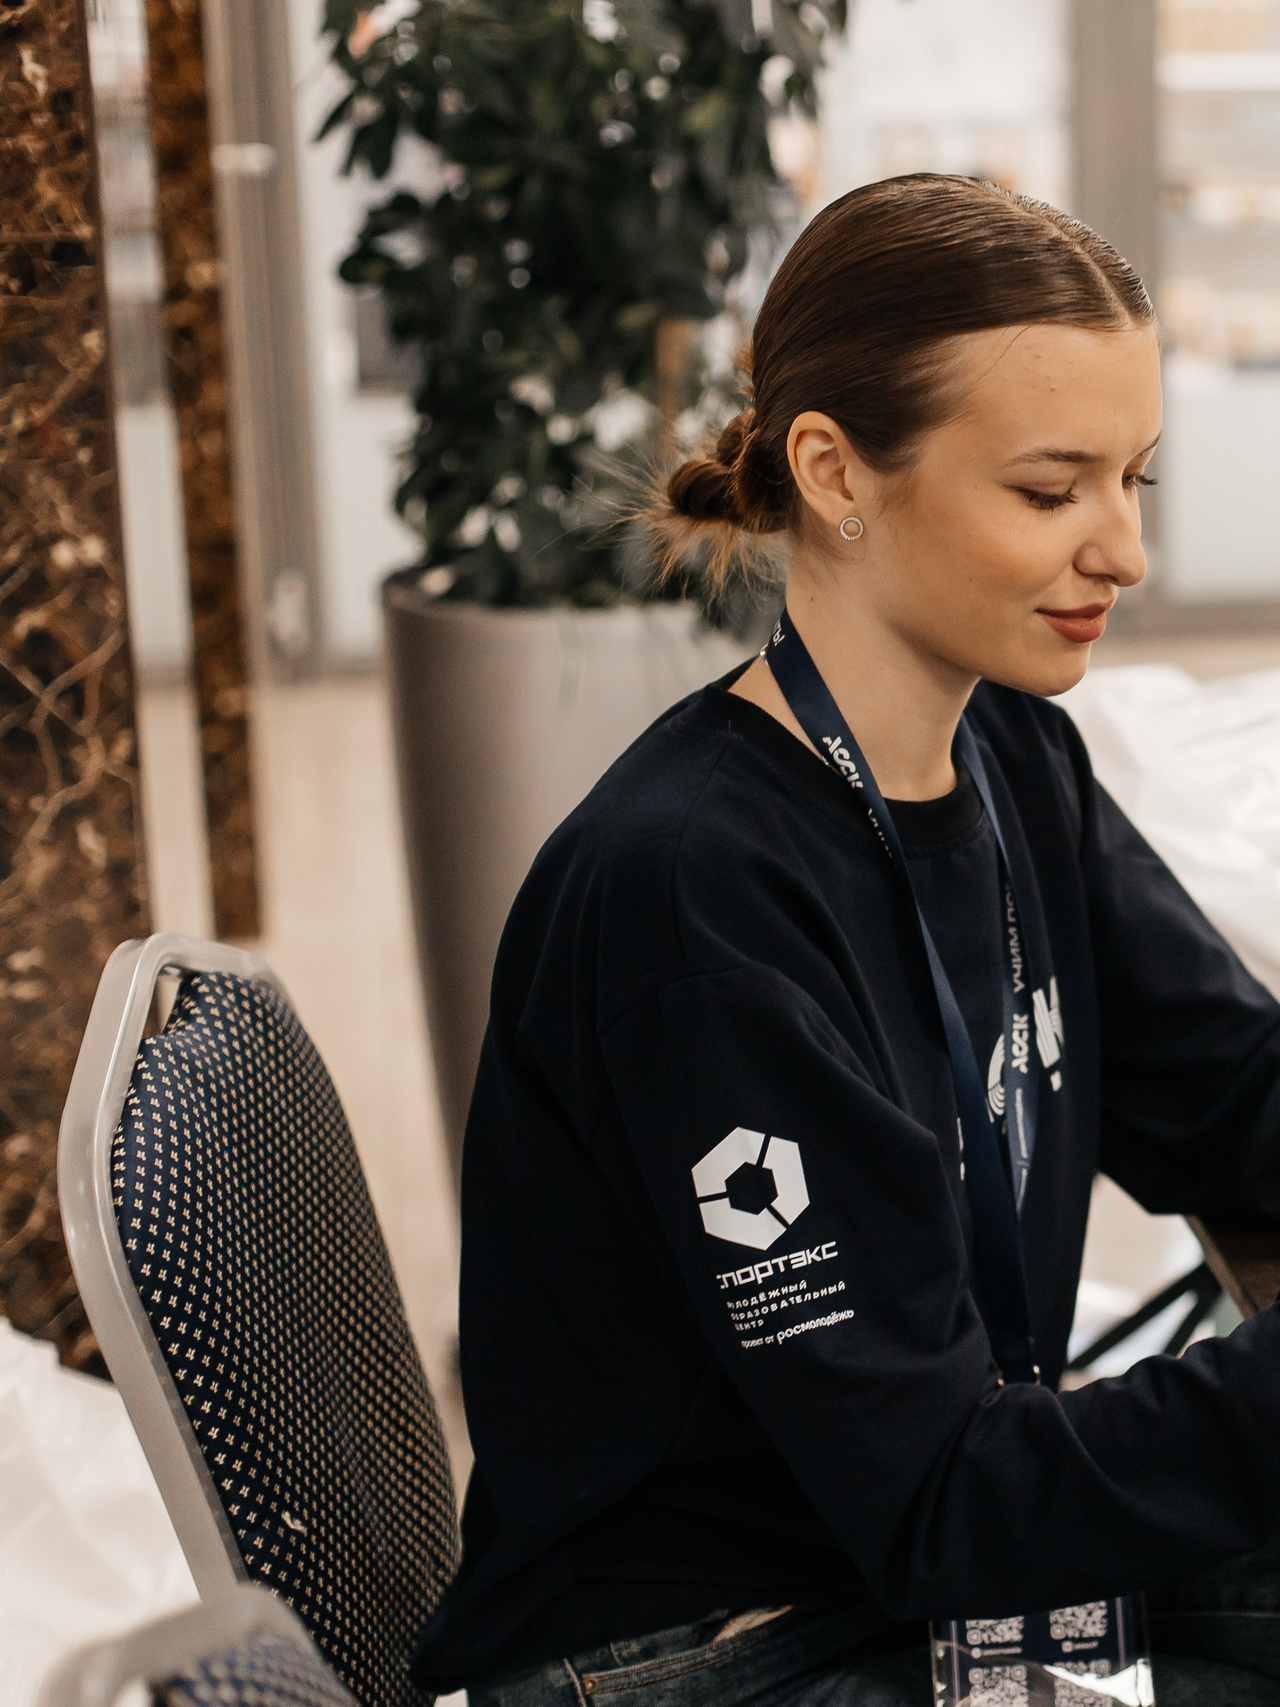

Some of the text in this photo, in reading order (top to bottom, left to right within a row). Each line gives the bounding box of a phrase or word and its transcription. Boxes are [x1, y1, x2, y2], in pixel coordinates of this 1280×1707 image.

[727, 1279, 808, 1310] ЛОДЁЖНЫЙ
[731, 1280, 847, 1322] РАЗОВАТЕЛЬНЫЙ
[734, 1318, 765, 1332] ЕНТР
